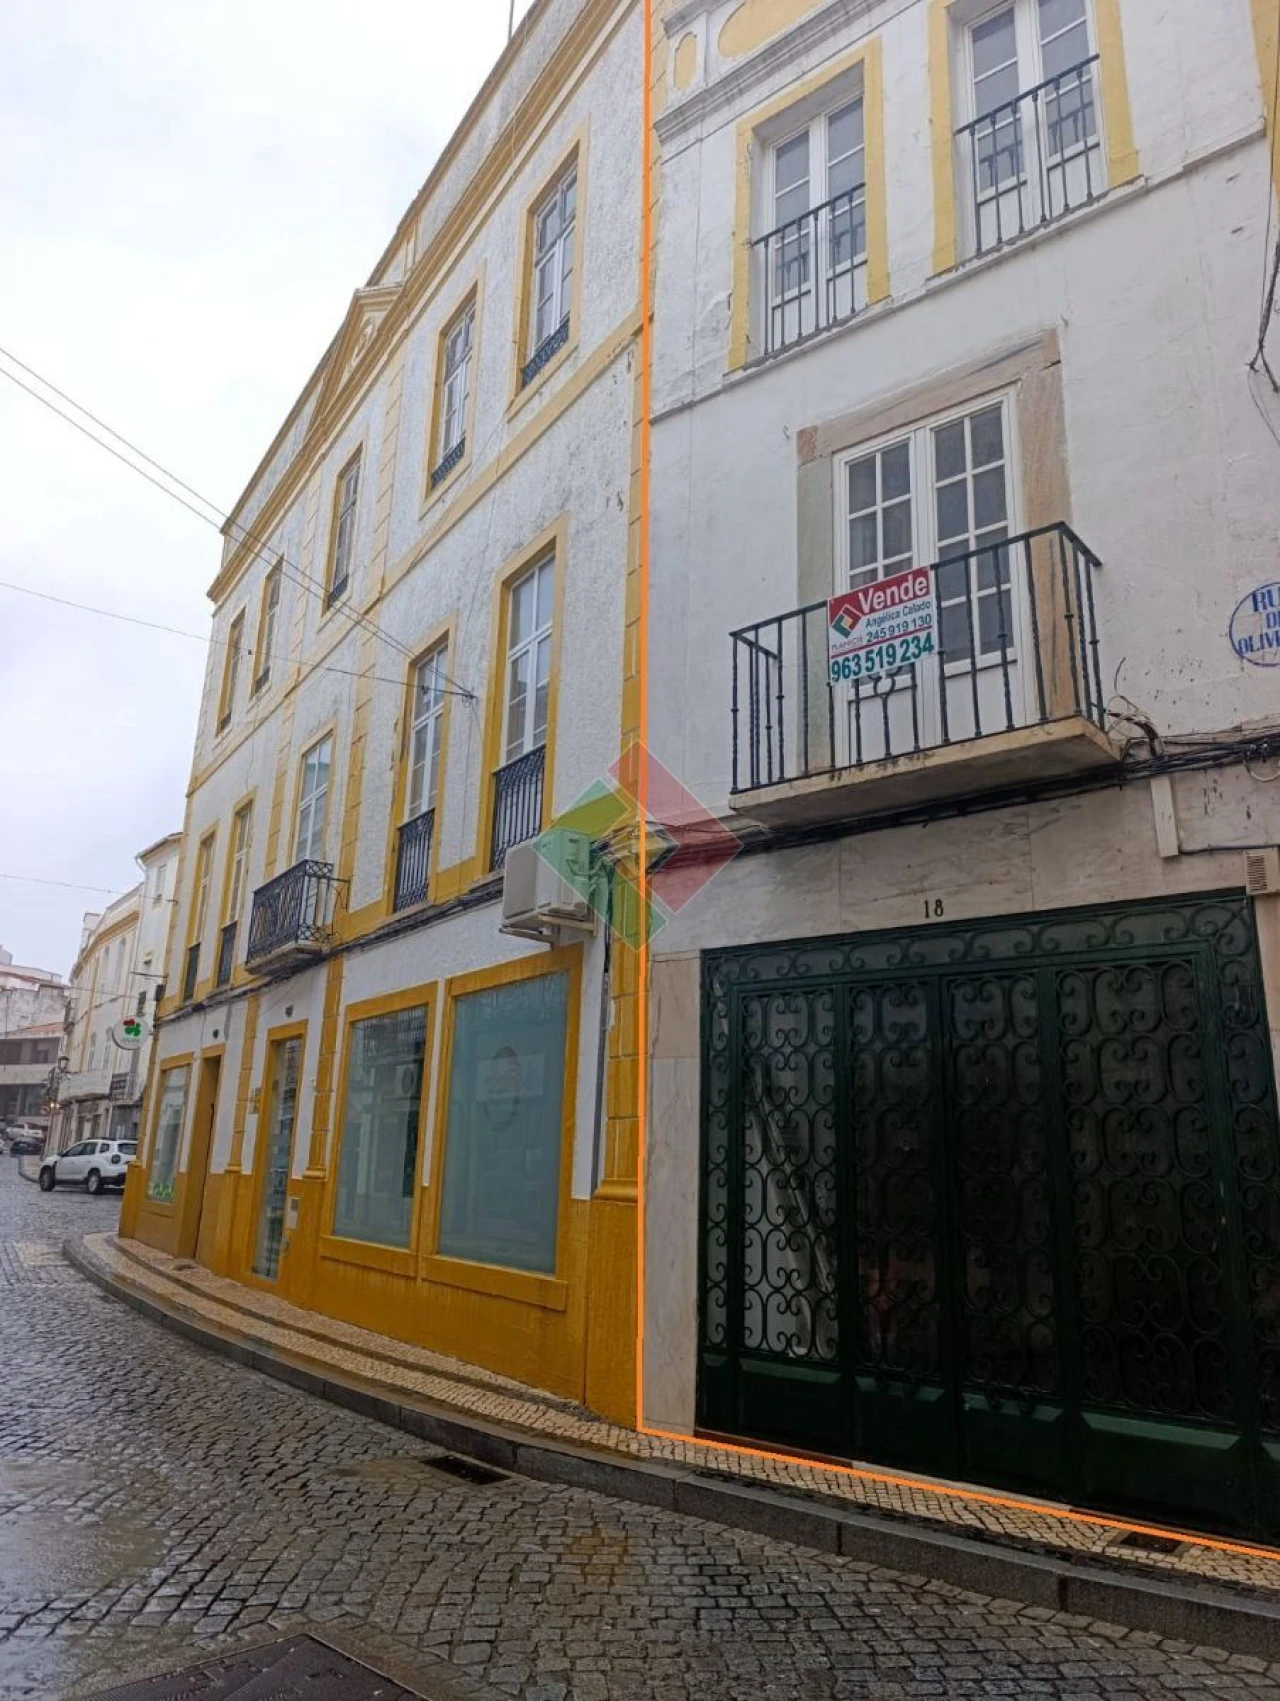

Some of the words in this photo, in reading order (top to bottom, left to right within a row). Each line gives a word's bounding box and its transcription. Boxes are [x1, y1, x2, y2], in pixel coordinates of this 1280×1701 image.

[858, 574, 928, 614] Vende
[911, 613, 932, 628] 130
[831, 653, 862, 682] 963
[865, 643, 897, 669] 519
[900, 632, 934, 662] 234
[923, 898, 944, 919] 18
